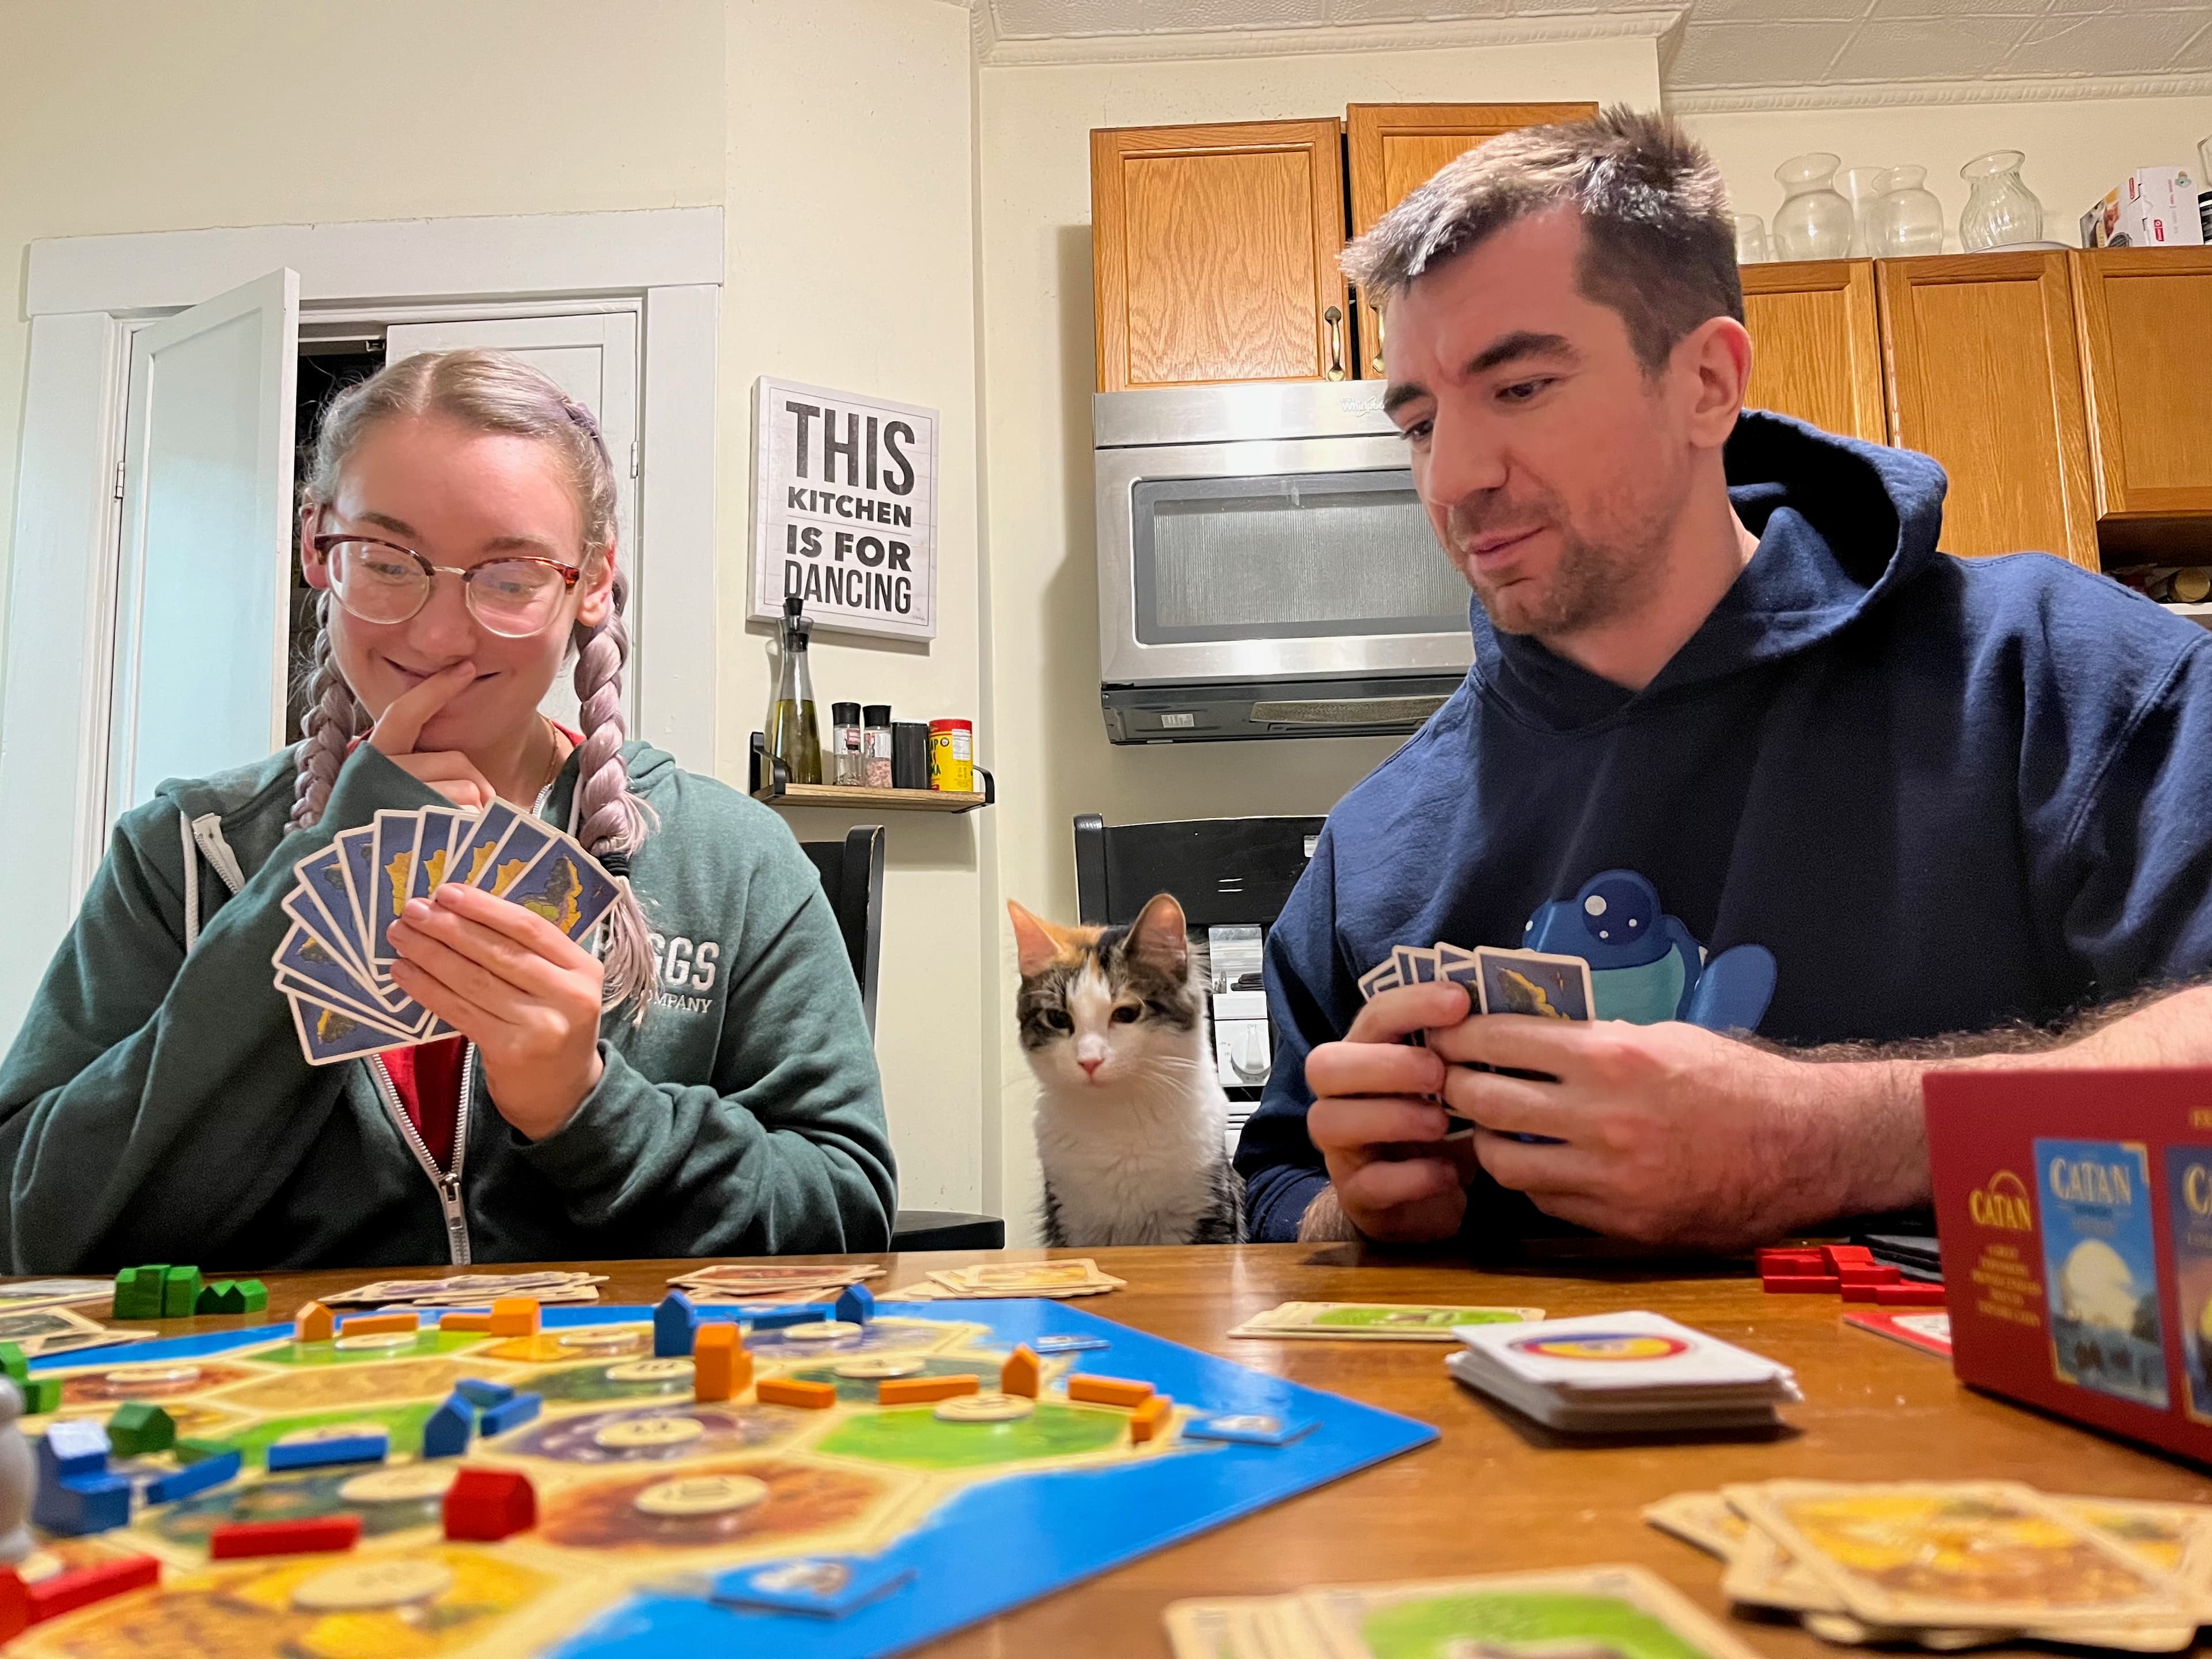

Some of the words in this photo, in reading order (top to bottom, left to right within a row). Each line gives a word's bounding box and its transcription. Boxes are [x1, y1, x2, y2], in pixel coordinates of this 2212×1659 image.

[1340, 397, 1385, 414] Whirlpoo
[786, 401, 915, 495] THIS
[788, 486, 912, 528] KITCHEN
[787, 524, 823, 558] IS
[835, 532, 912, 573] FOR
[785, 559, 912, 615] DANCING
[629, 988, 713, 1013] OMPANY
[2050, 1158, 2131, 1205] CATAN
[1969, 1188, 2032, 1232] CATAN
